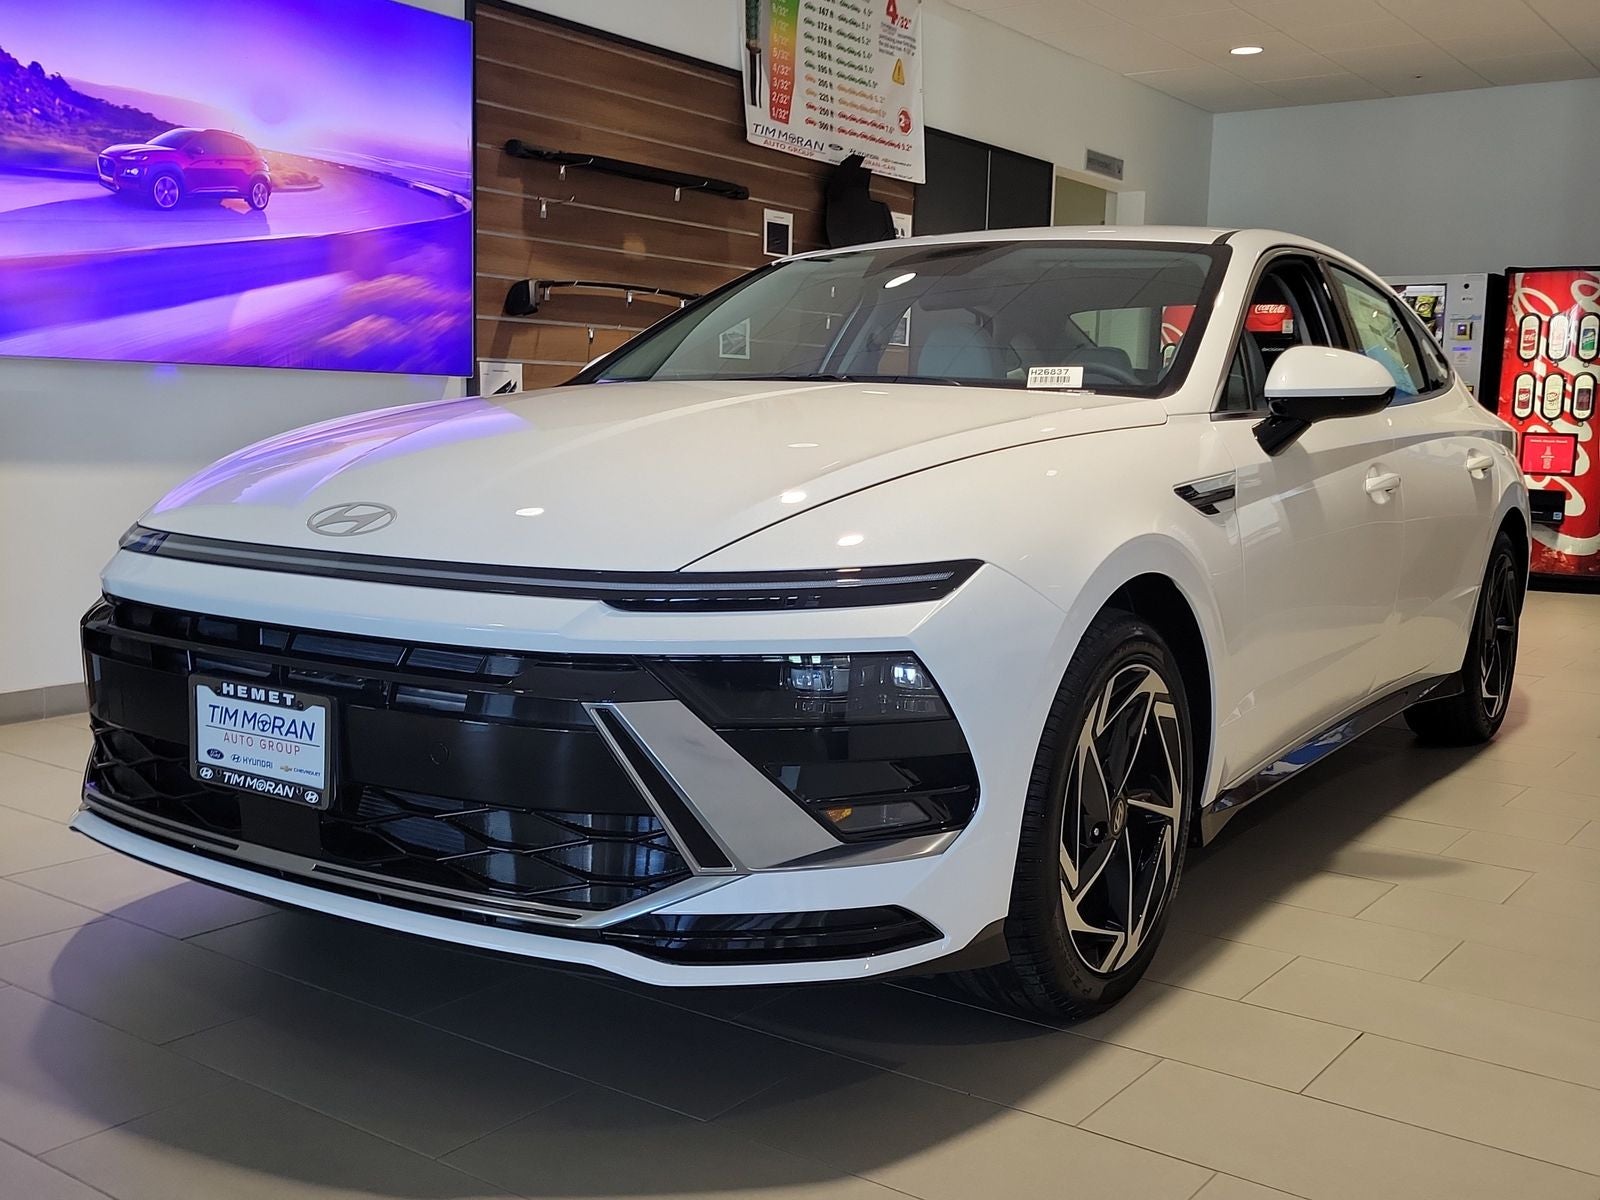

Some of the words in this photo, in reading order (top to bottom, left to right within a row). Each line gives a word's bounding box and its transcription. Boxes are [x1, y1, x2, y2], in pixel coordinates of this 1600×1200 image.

[772, 91, 791, 105] 2/32"
[772, 107, 789, 120] 1/32"
[753, 122, 776, 138] TIM
[778, 130, 824, 151] MORAN
[763, 139, 786, 150] AUTO
[1030, 368, 1070, 376] H26837
[222, 682, 295, 706] HEMET
[208, 704, 238, 727] TIM
[241, 710, 316, 742] MORAN
[224, 732, 254, 747] AUTO
[260, 739, 300, 756] GROUP
[242, 756, 273, 769] HYUNDAI
[223, 772, 244, 787] TIM
[245, 778, 294, 798] MORAN
